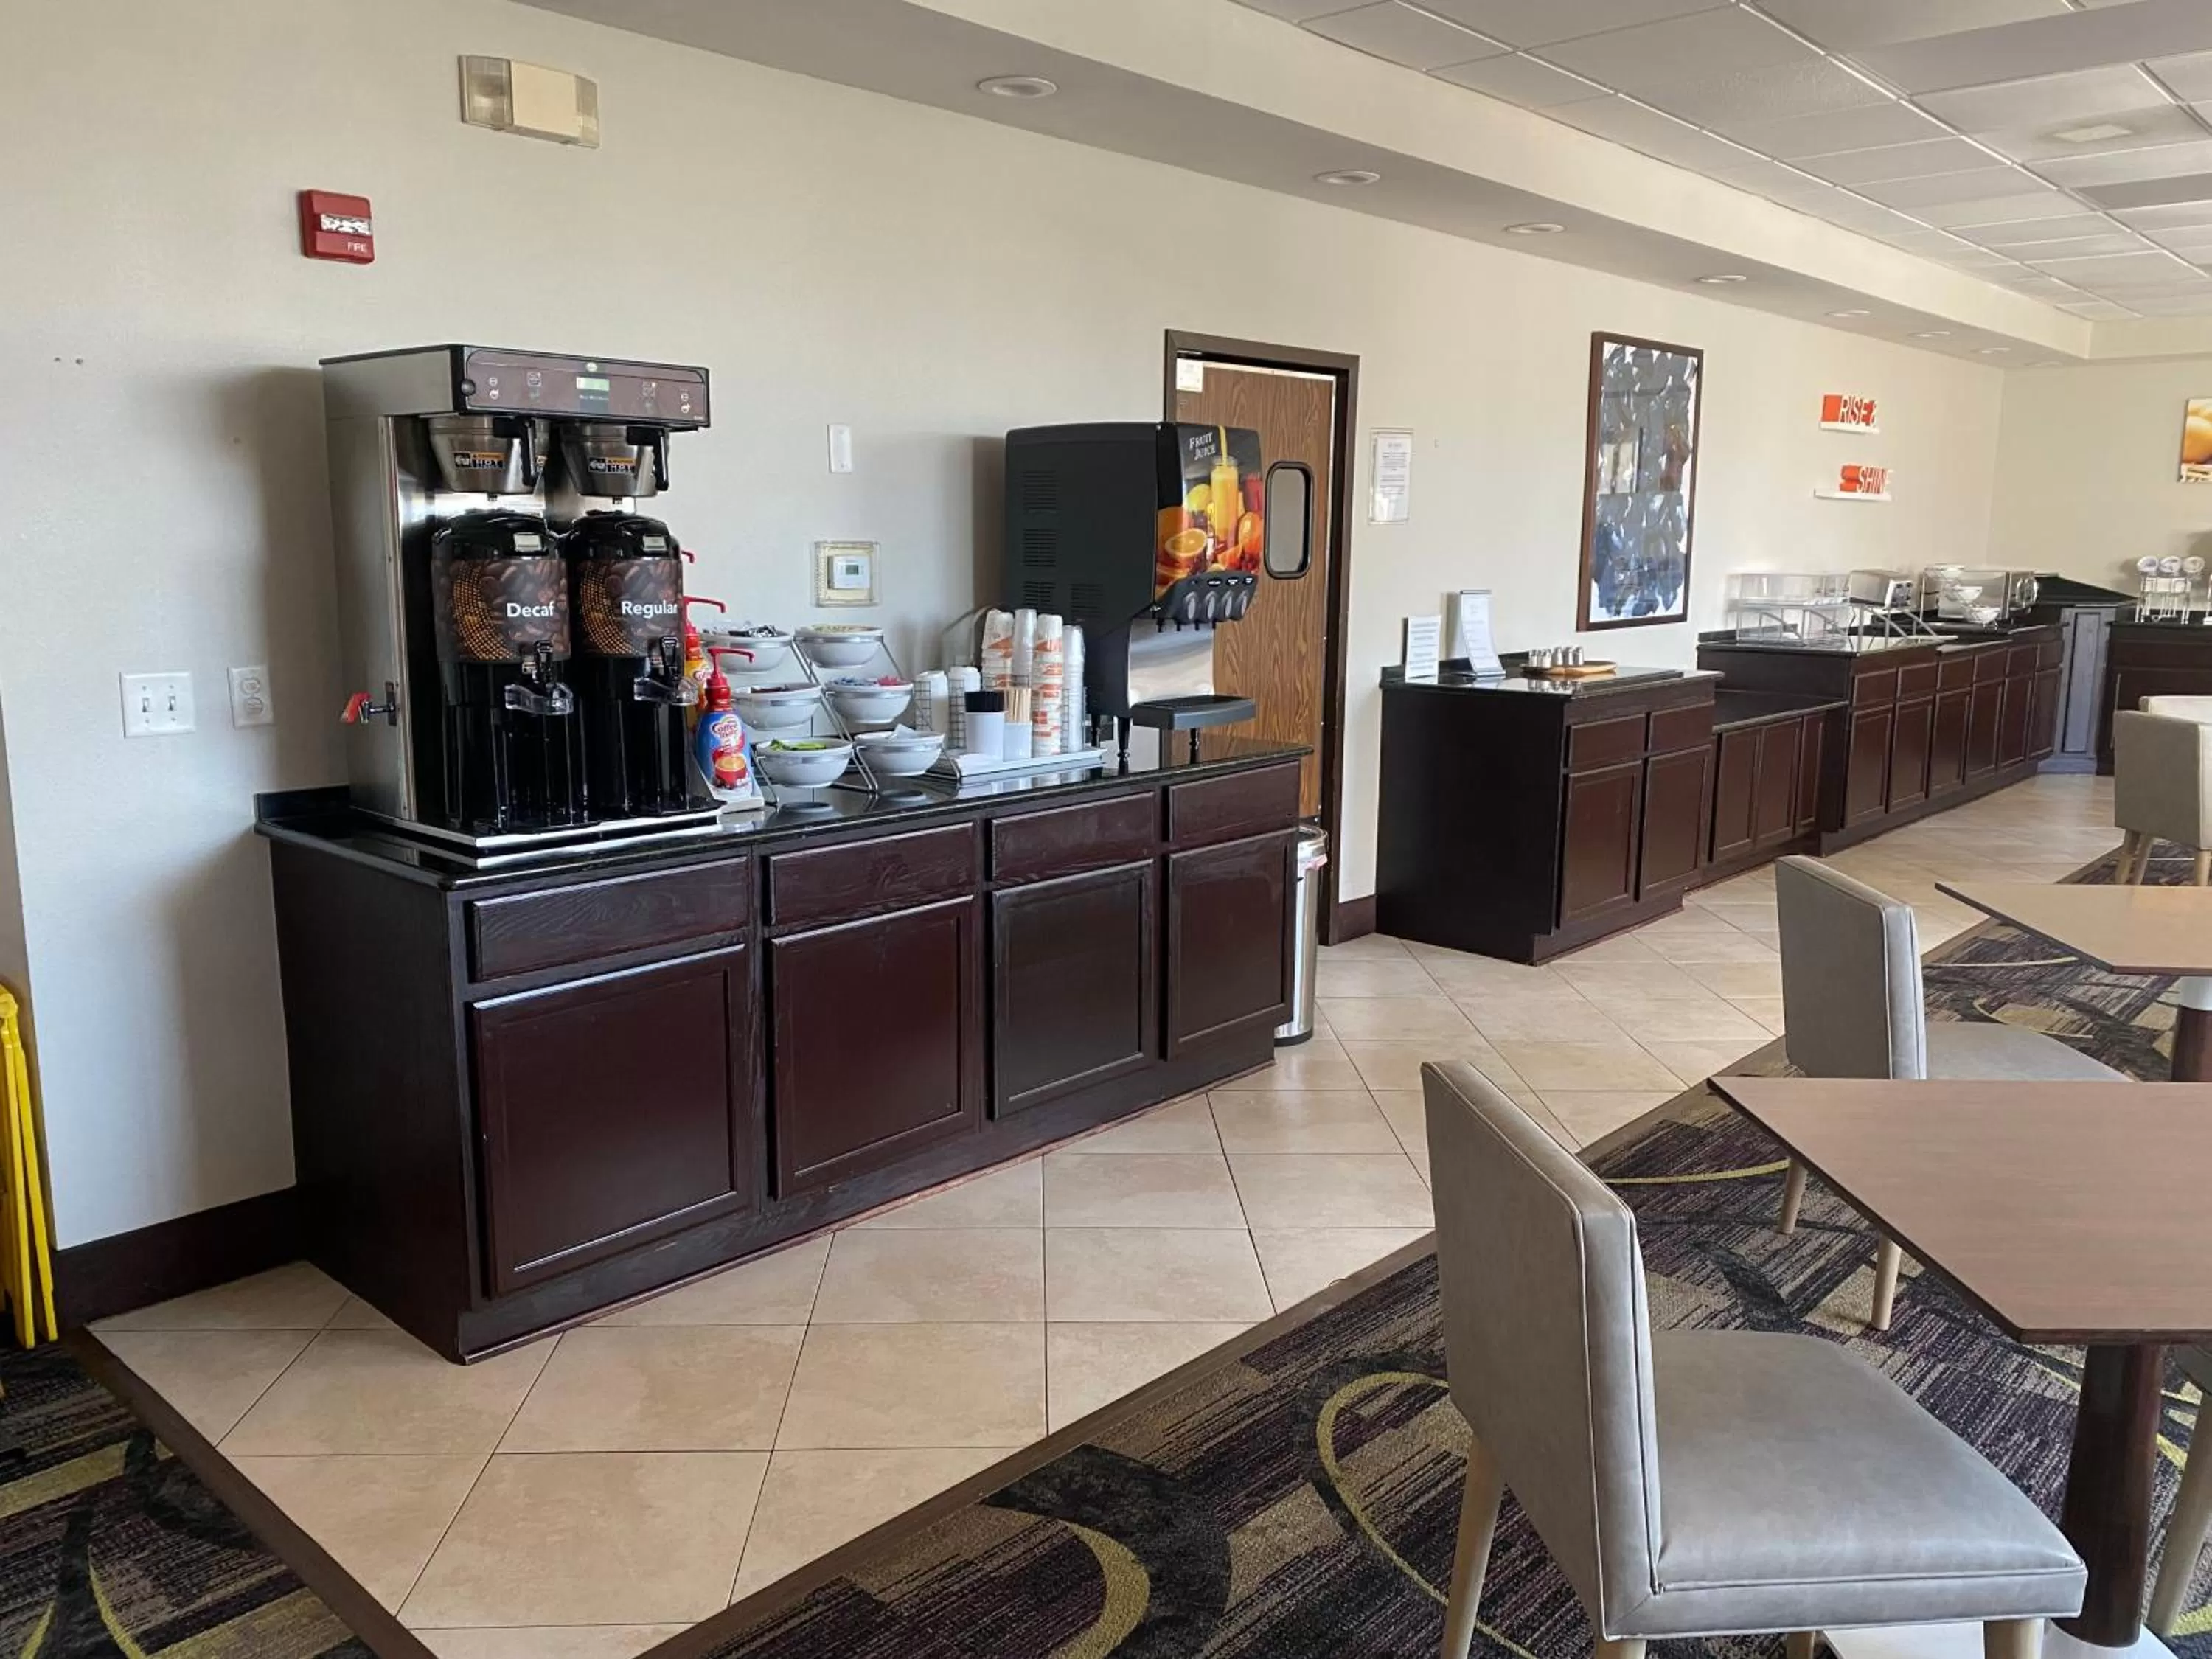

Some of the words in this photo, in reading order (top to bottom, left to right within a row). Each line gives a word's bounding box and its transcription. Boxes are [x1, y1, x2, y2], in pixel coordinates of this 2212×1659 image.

[1840, 394, 1868, 424] RISE
[1189, 431, 1213, 450] FRUIT
[1194, 443, 1216, 461] JUICE
[507, 601, 554, 617] Decaf
[621, 600, 678, 619] Regular
